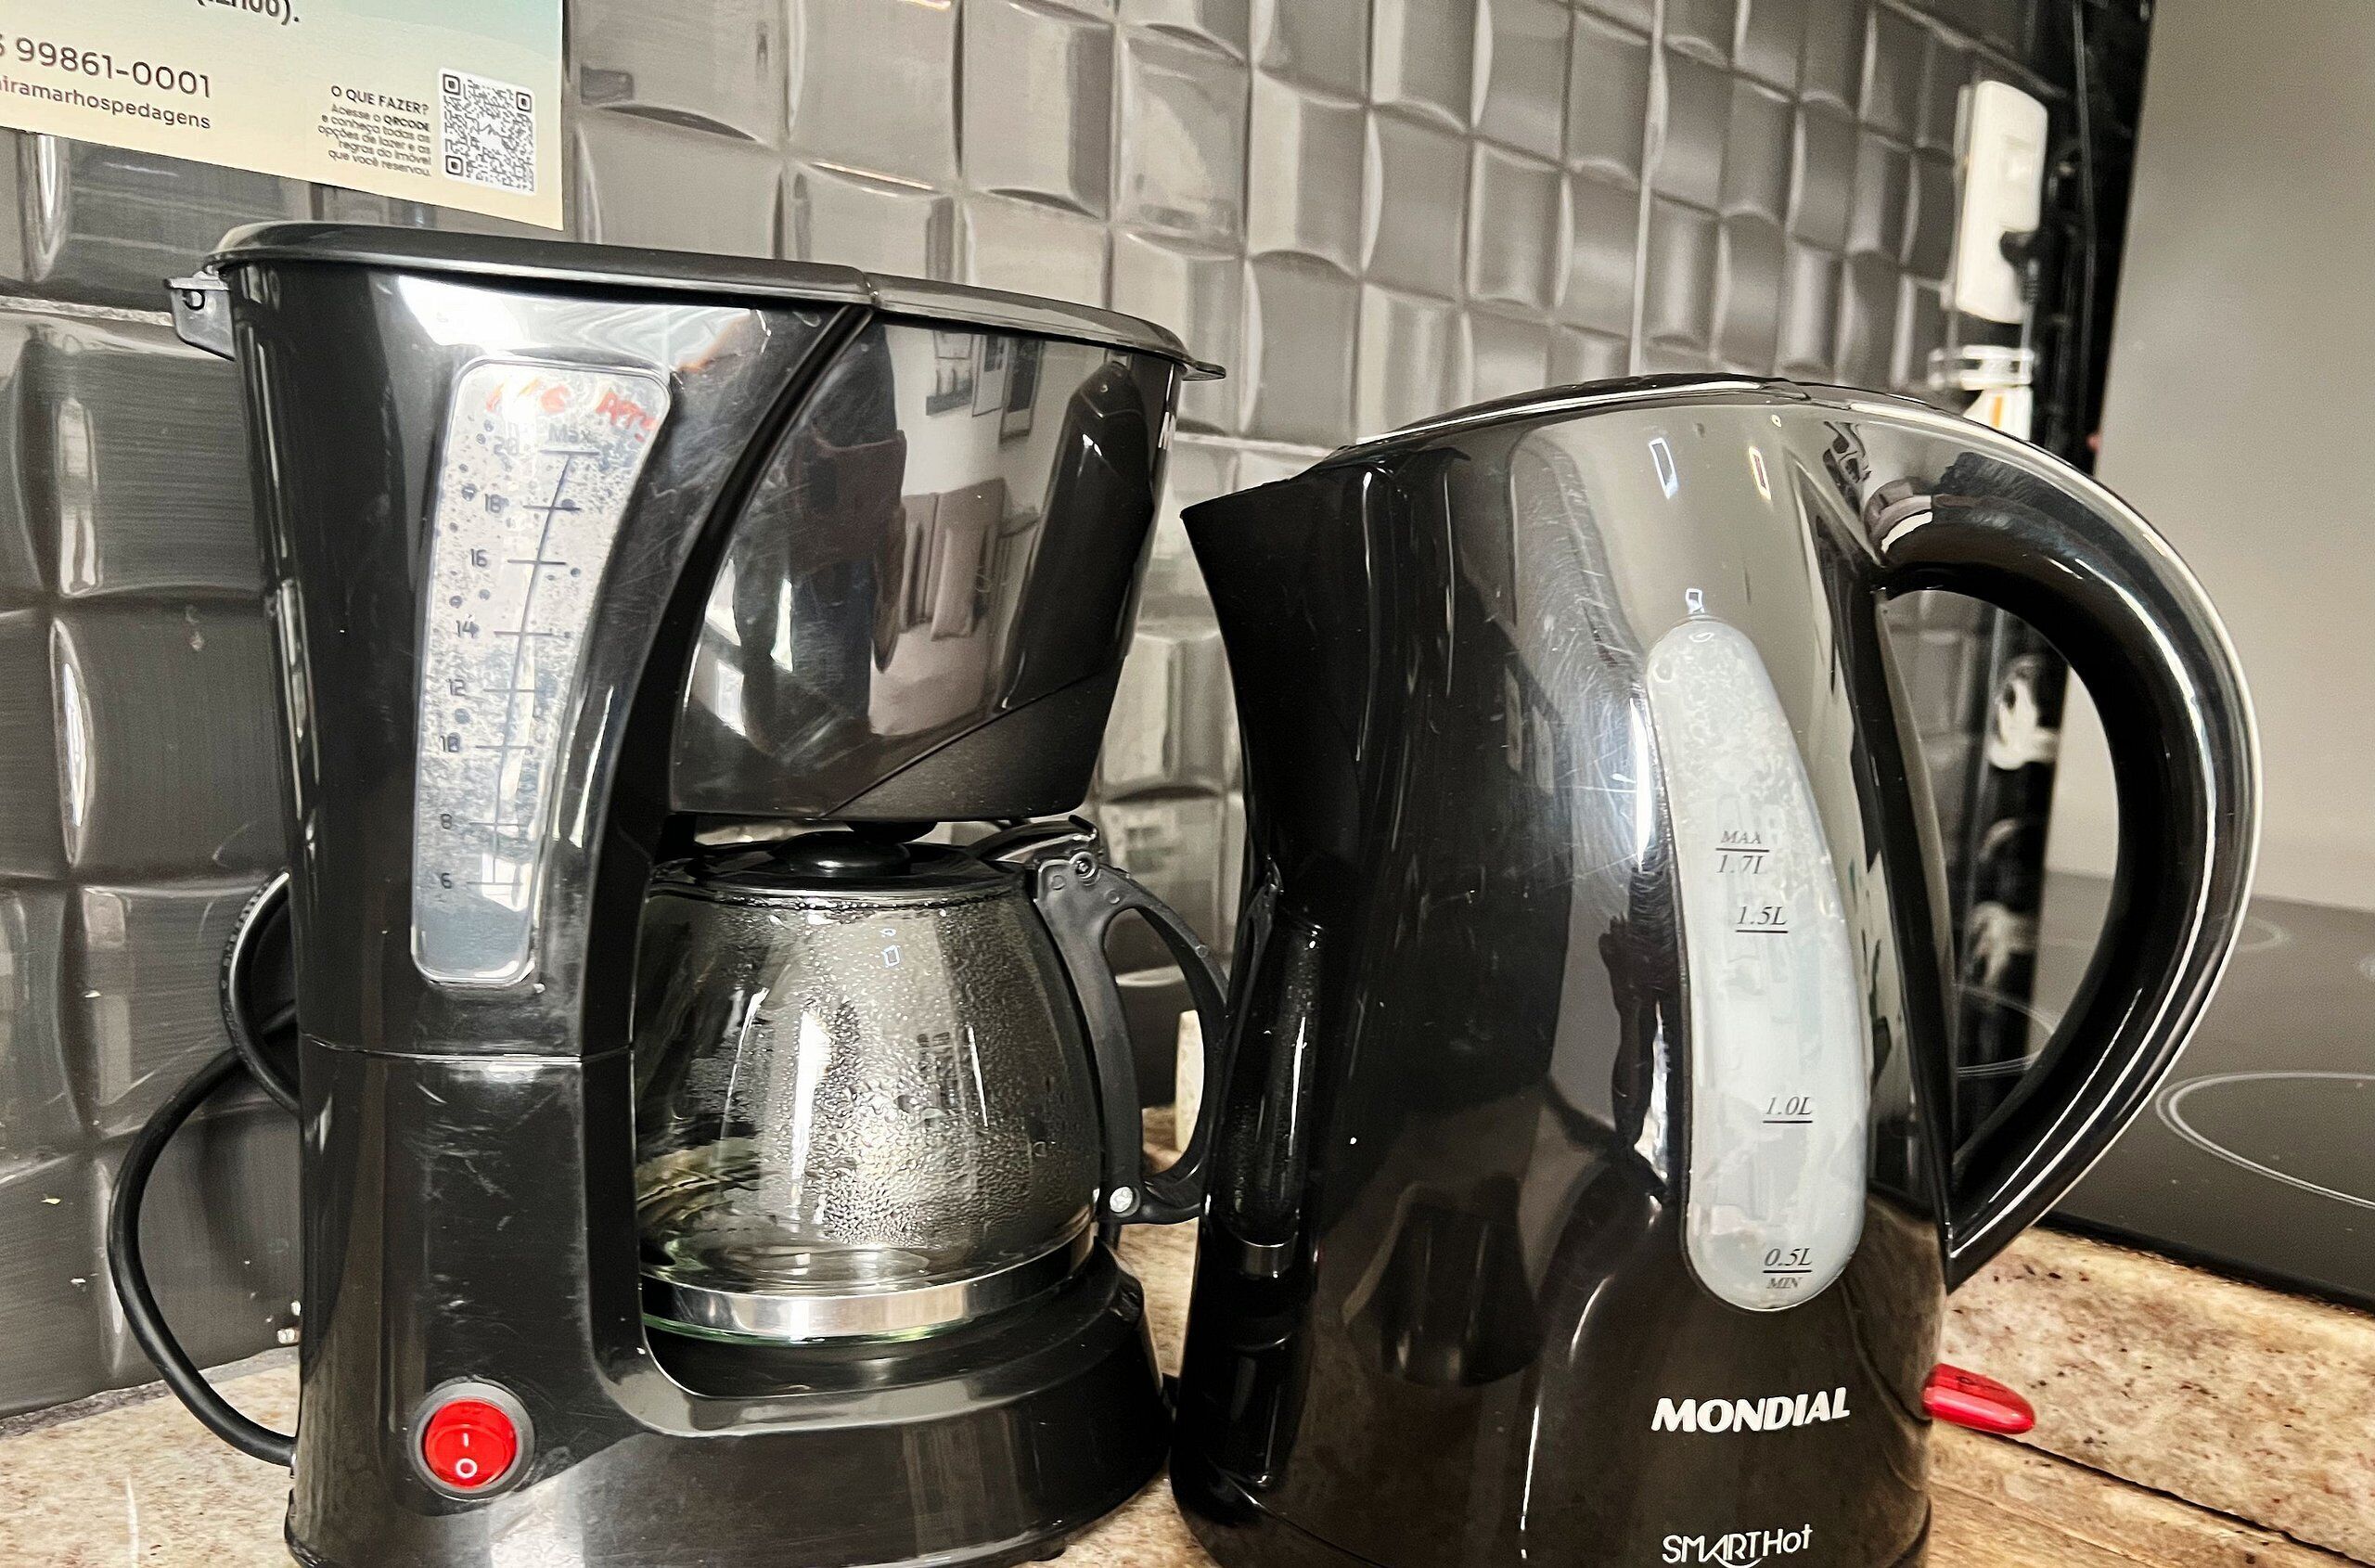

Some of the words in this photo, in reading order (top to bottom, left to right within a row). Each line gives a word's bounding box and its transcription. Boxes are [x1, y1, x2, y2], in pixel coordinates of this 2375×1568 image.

[16, 37, 211, 98] 99861-0001
[0, 75, 212, 129] iramarhospedagens
[331, 85, 341, 96] O
[346, 89, 375, 105] QUE
[378, 95, 430, 115] FAZER?
[470, 548, 488, 568] 16
[446, 678, 465, 696] 12
[441, 813, 453, 830] 8
[440, 872, 452, 889] 6
[1737, 906, 1788, 925] 1.5L
[1765, 1096, 1812, 1115] 1.0L
[1764, 1248, 1812, 1266] 0.5L
[1650, 1387, 1851, 1433] MONDIAL
